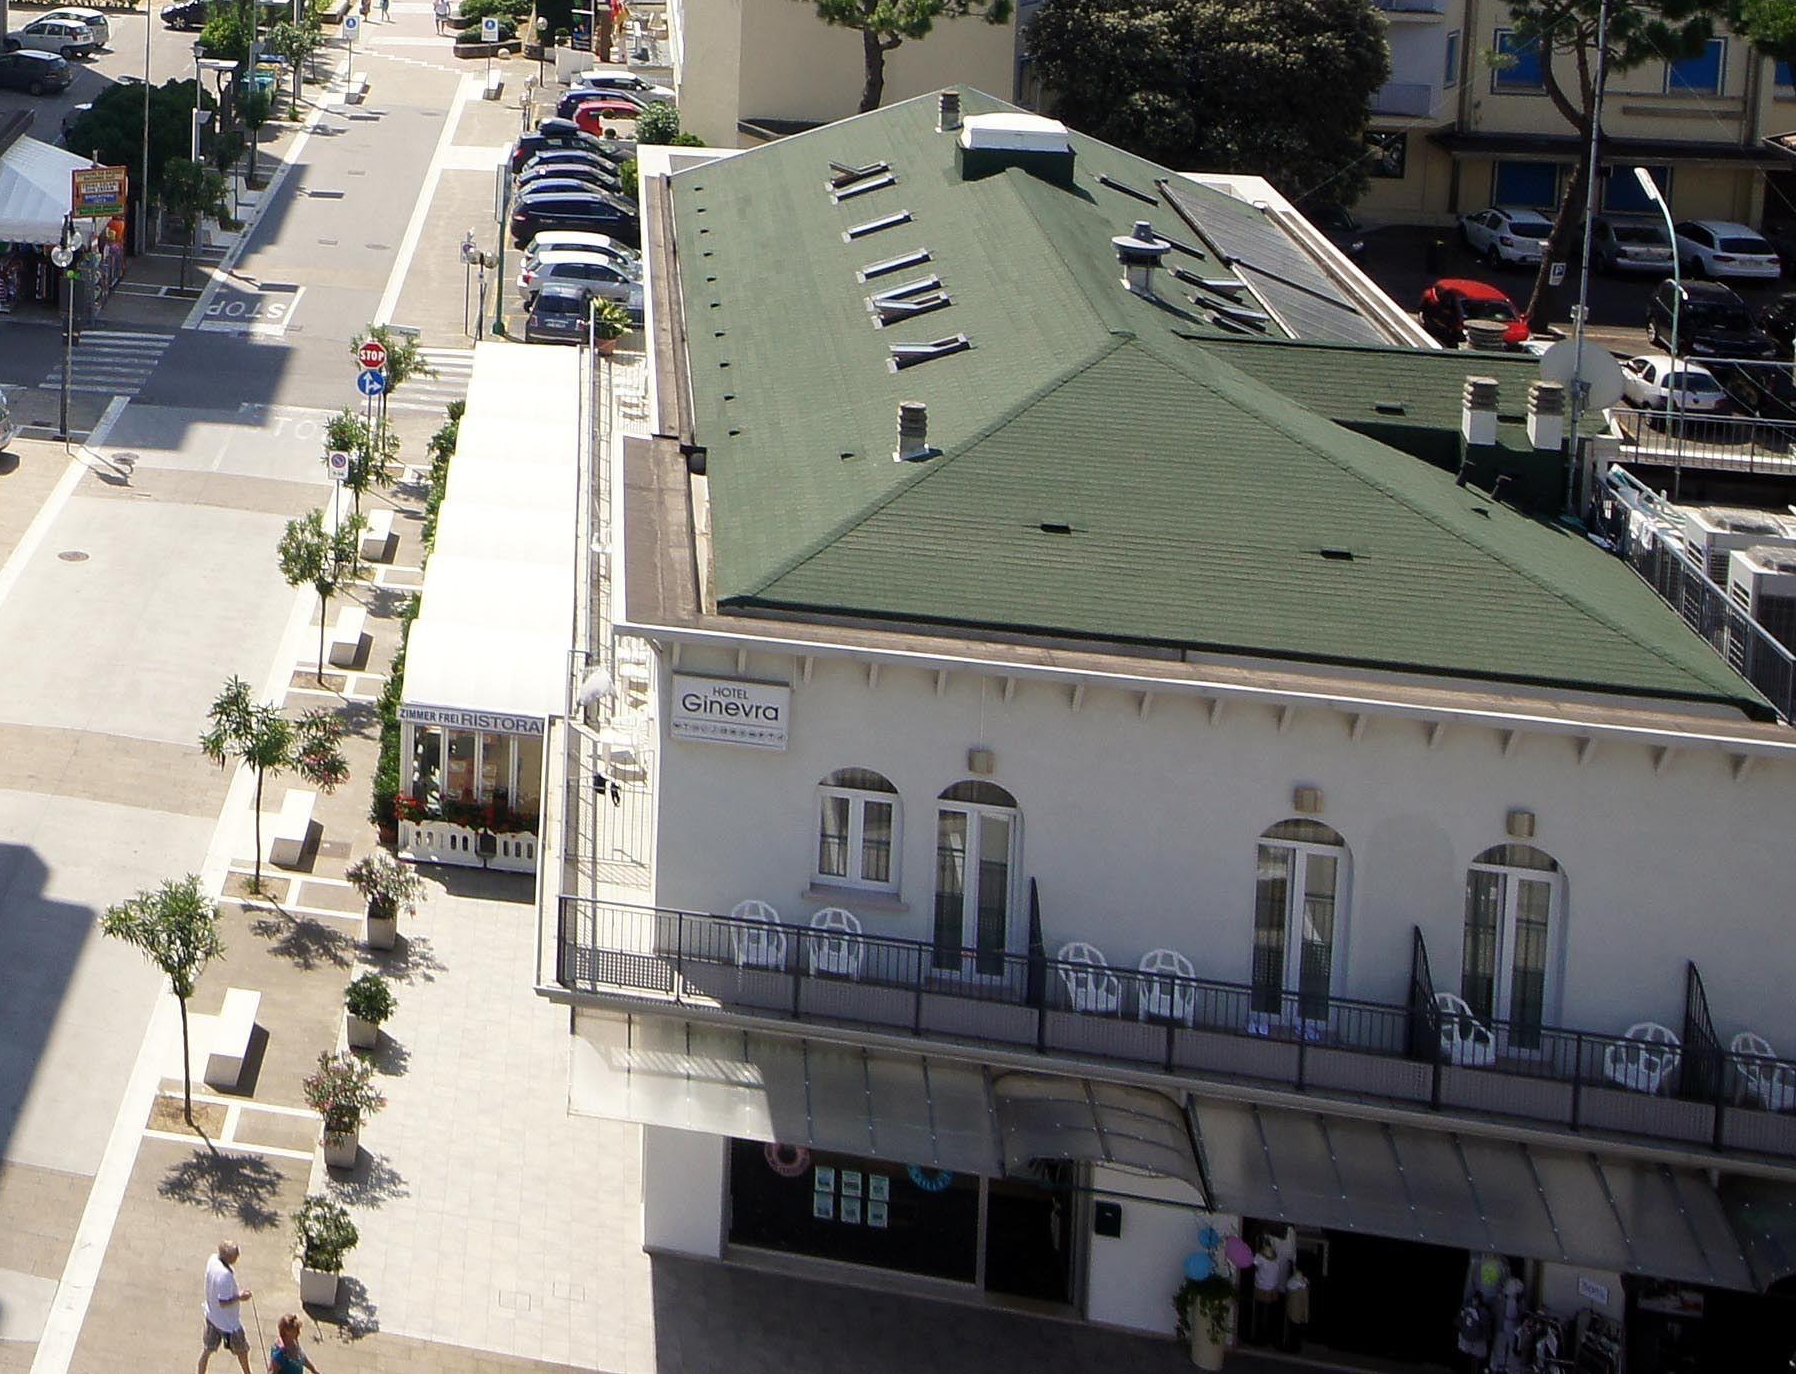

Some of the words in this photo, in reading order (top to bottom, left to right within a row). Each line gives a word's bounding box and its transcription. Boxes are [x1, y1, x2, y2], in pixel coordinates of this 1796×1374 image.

[206, 301, 287, 318] STOP
[360, 350, 384, 362] STOP
[712, 686, 749, 701] HOTEL
[682, 692, 779, 722] Ginevra
[399, 708, 436, 723] ZIMMER
[438, 712, 459, 724] FREI
